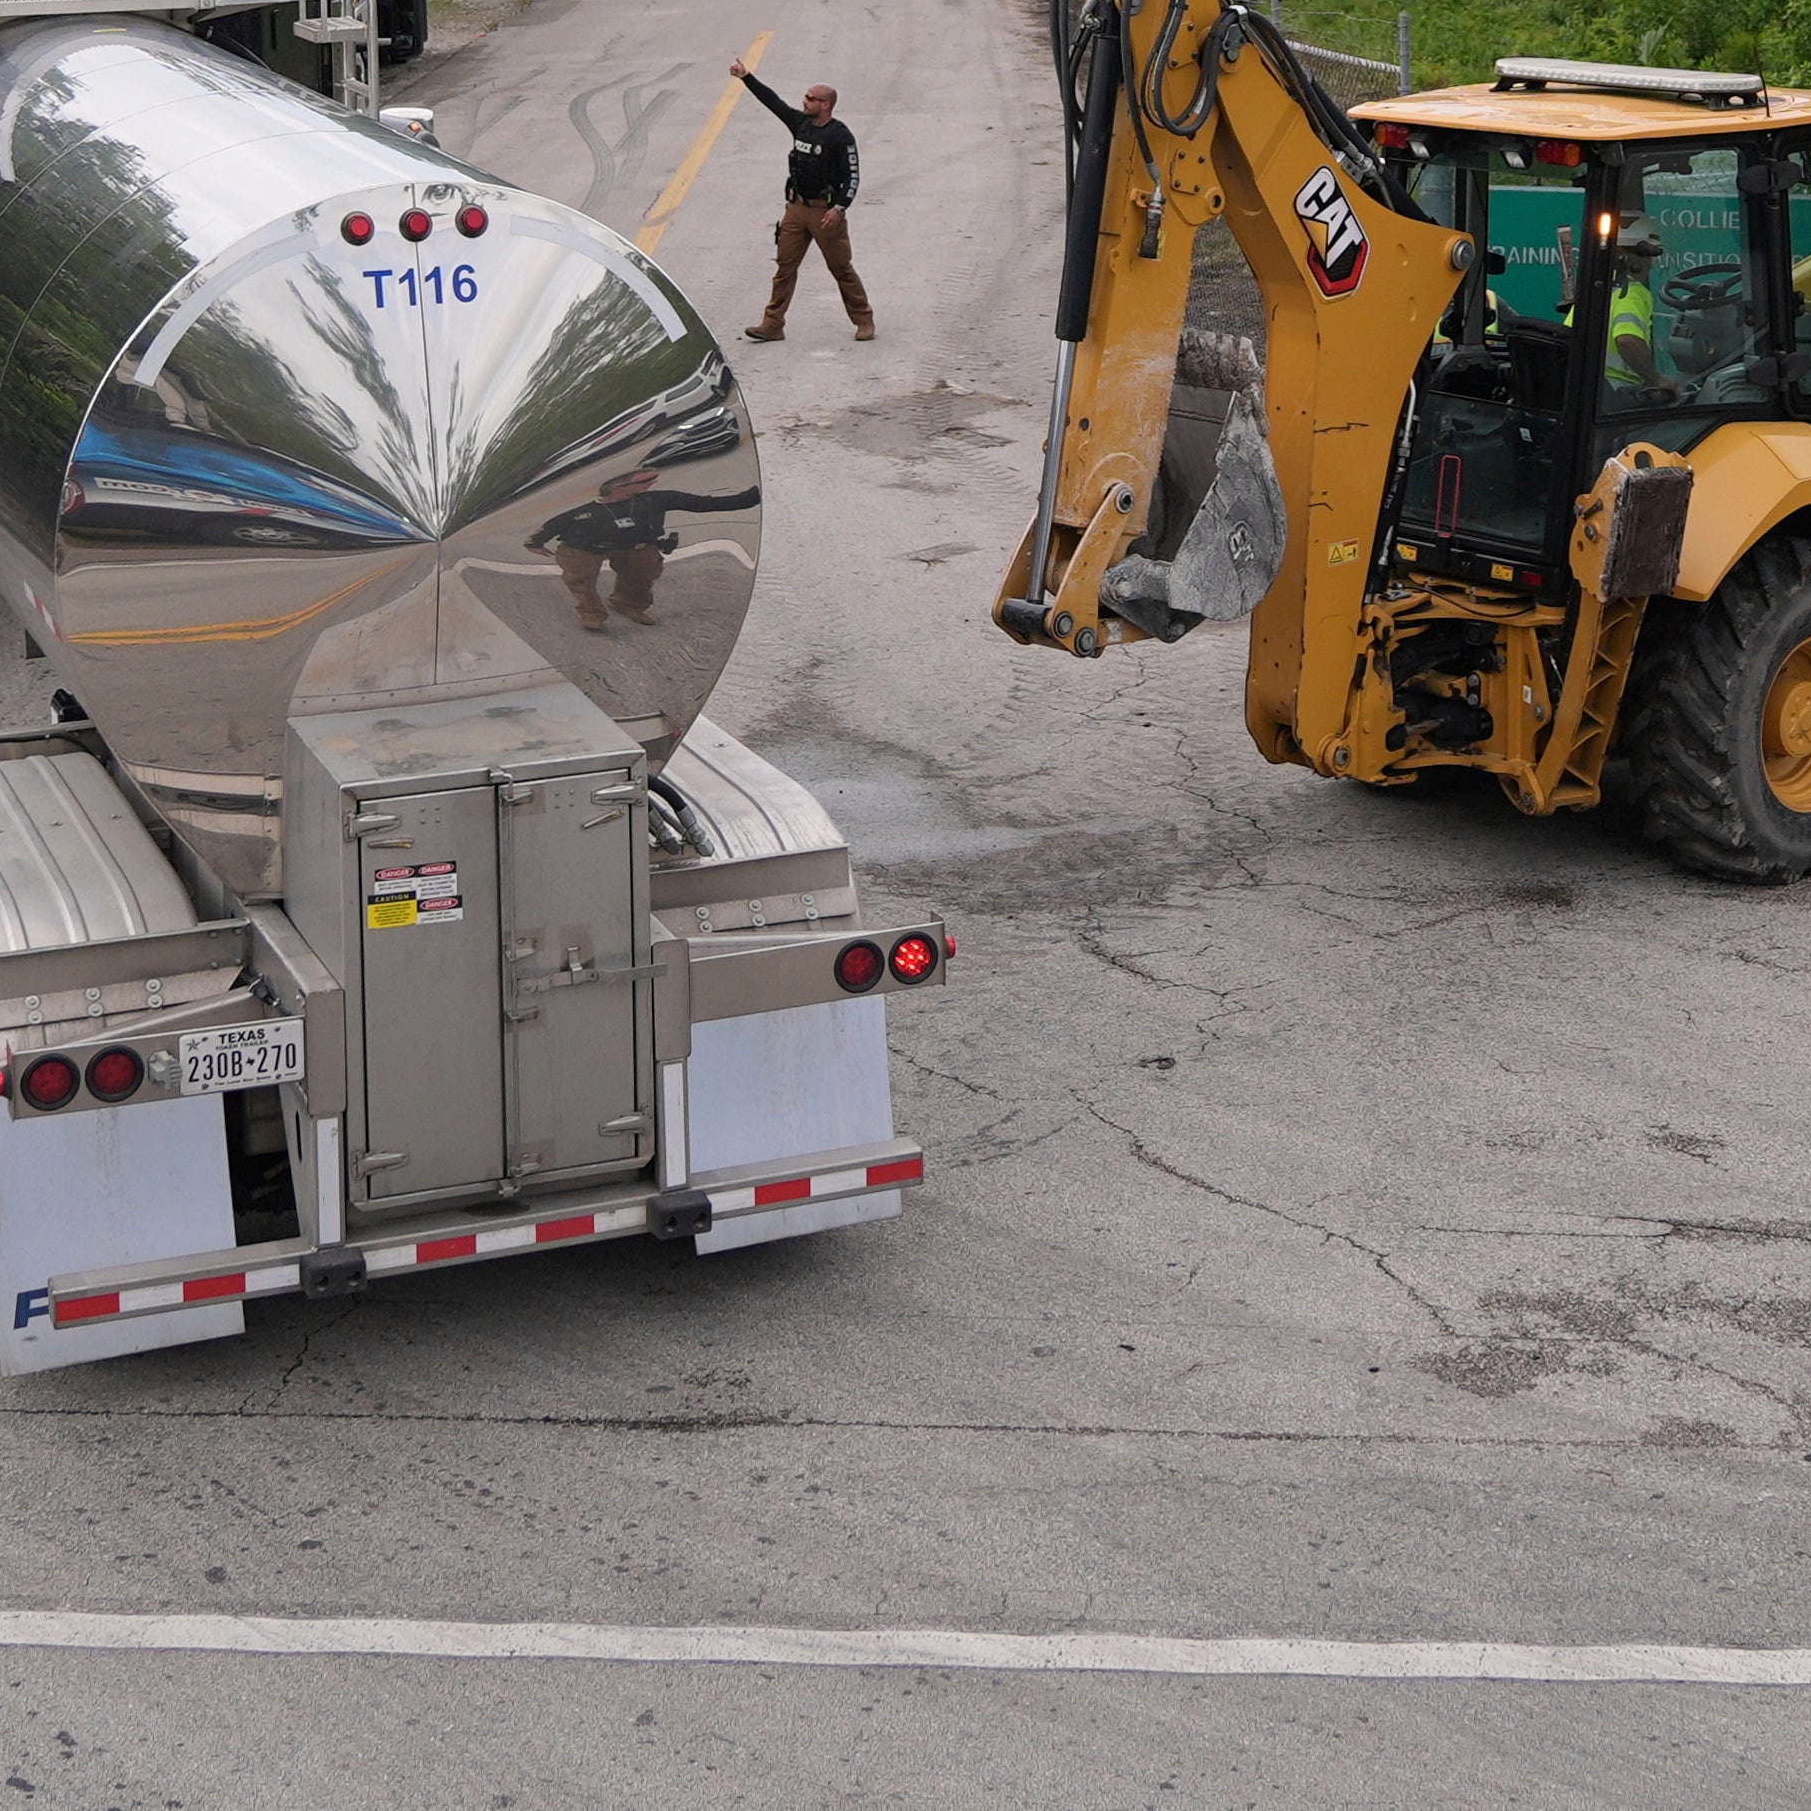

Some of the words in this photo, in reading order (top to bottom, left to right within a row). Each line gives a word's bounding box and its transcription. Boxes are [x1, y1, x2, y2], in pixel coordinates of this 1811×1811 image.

[1295, 167, 1364, 269] CAT
[362, 264, 478, 308] T116
[218, 1028, 265, 1045] TEXAS
